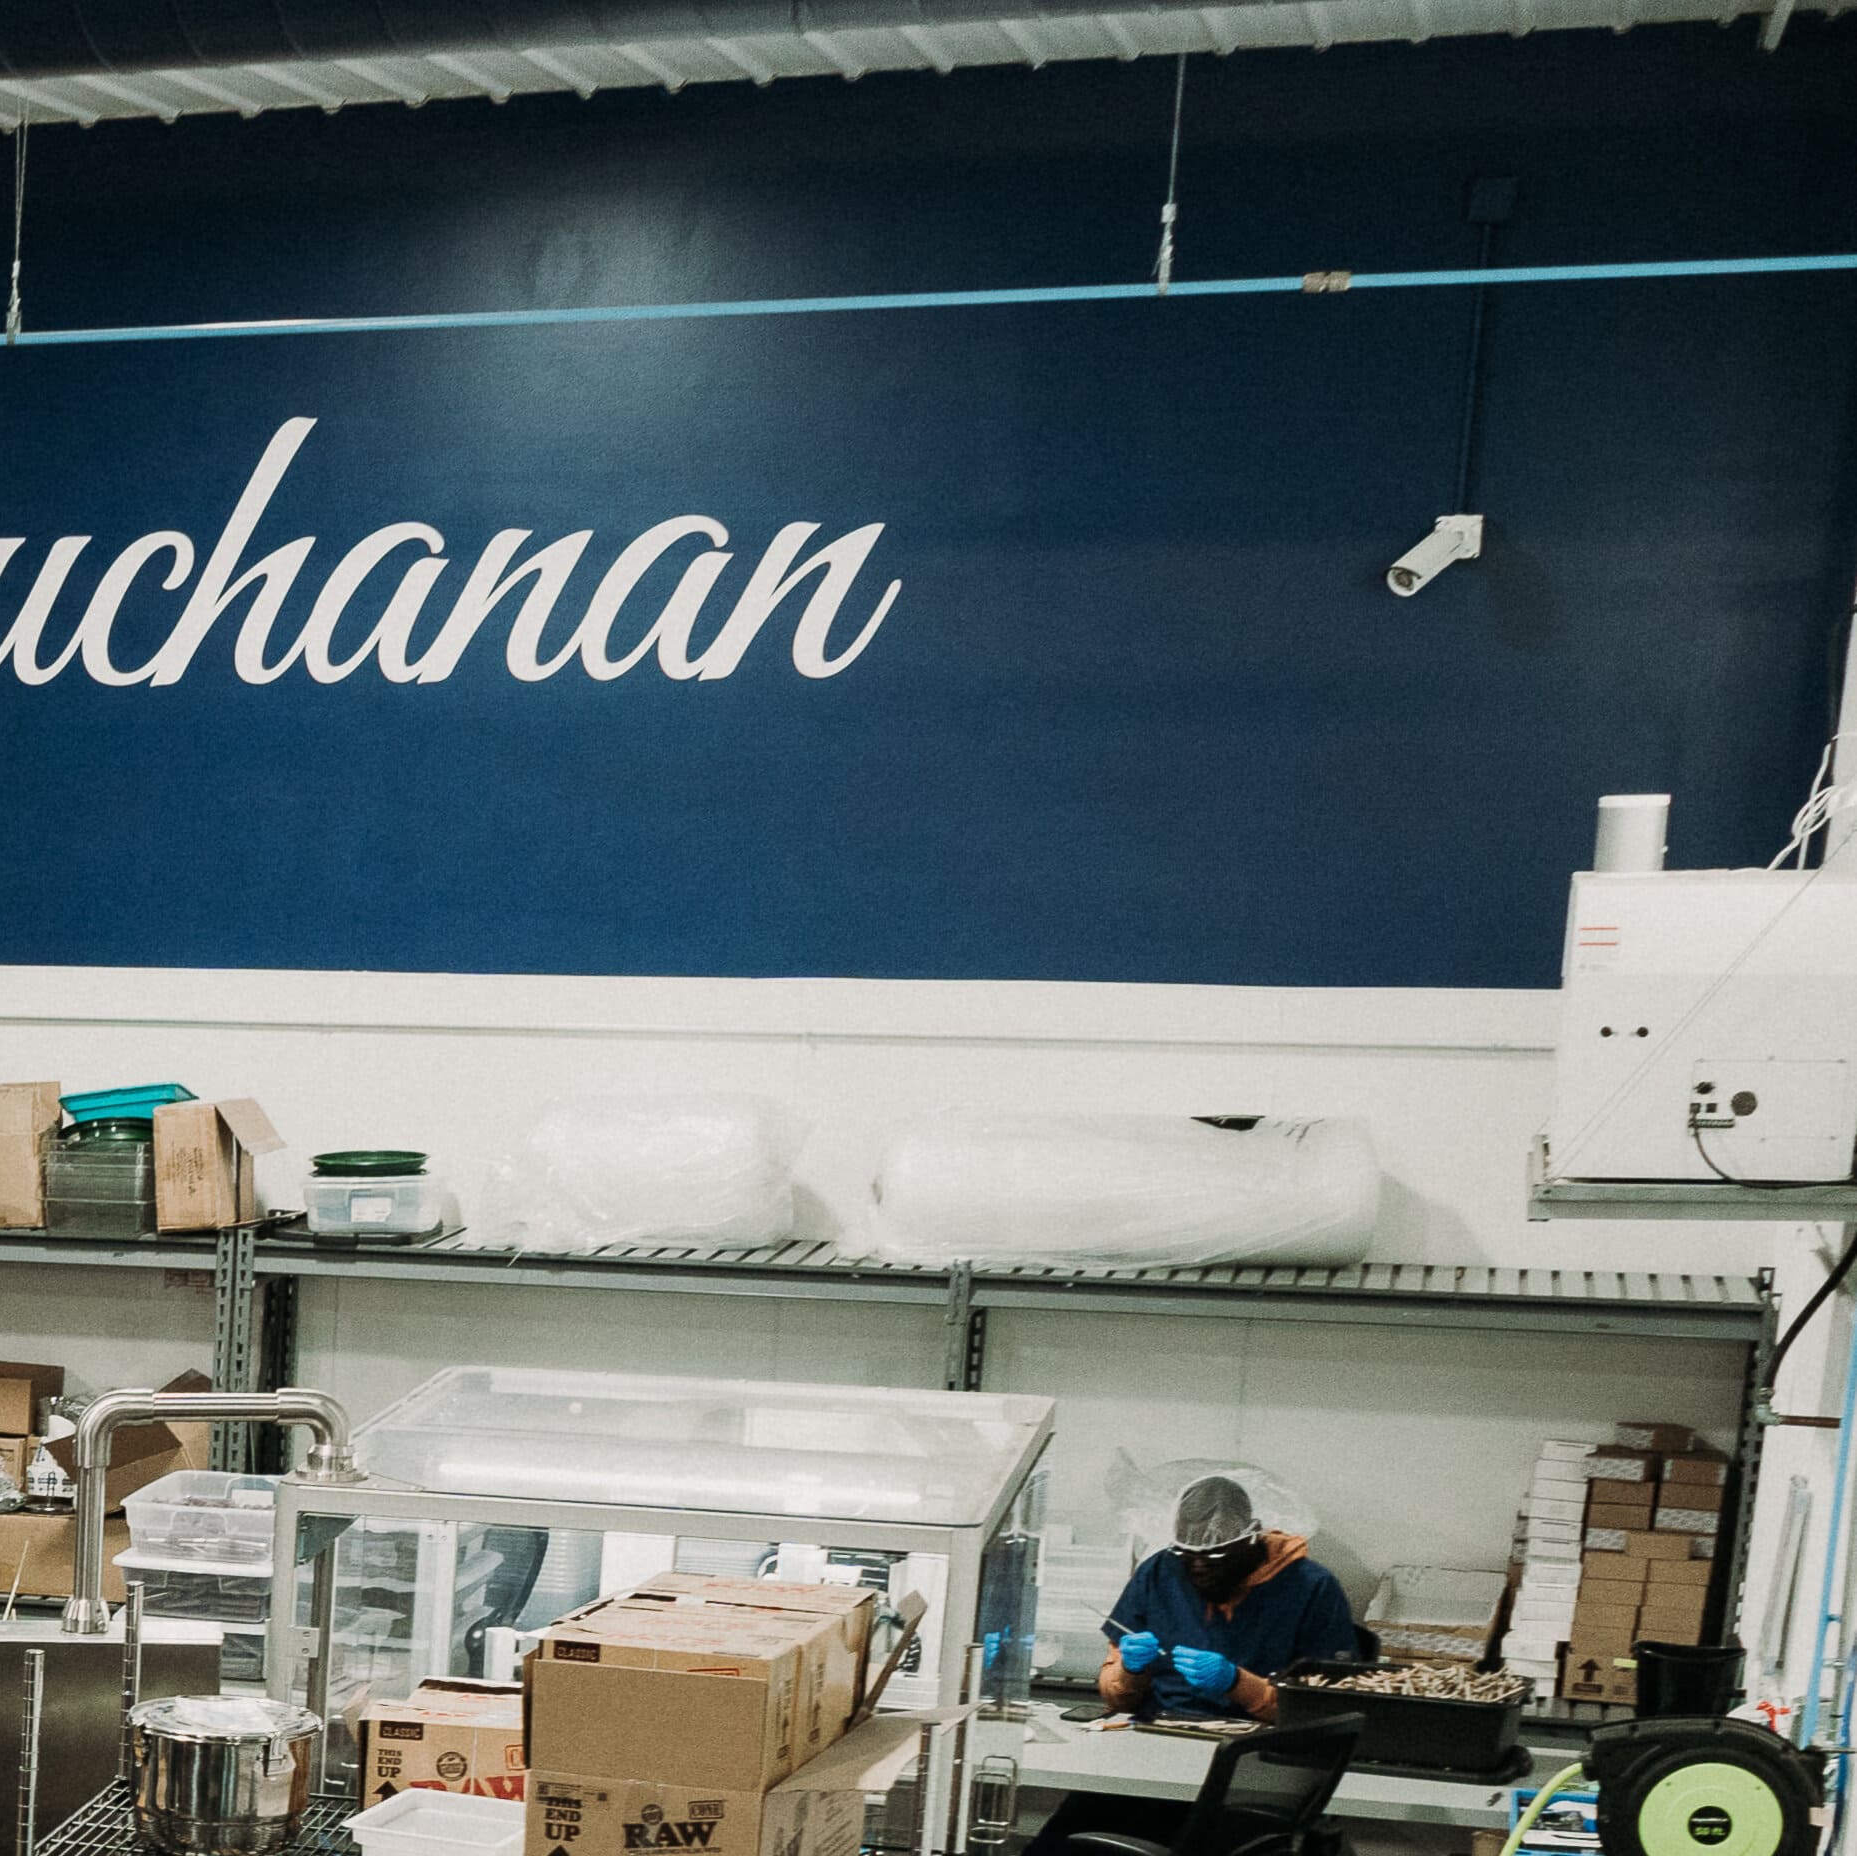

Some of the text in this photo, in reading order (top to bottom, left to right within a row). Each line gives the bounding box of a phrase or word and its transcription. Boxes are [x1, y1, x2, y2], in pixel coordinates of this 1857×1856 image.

[378, 1749, 402, 1757] THIS
[378, 1757, 402, 1766] END
[378, 1766, 401, 1778] UP
[545, 1797, 581, 1809] THIS
[545, 1809, 581, 1822] END
[545, 1823, 580, 1841] UP
[624, 1822, 717, 1848] RAW
